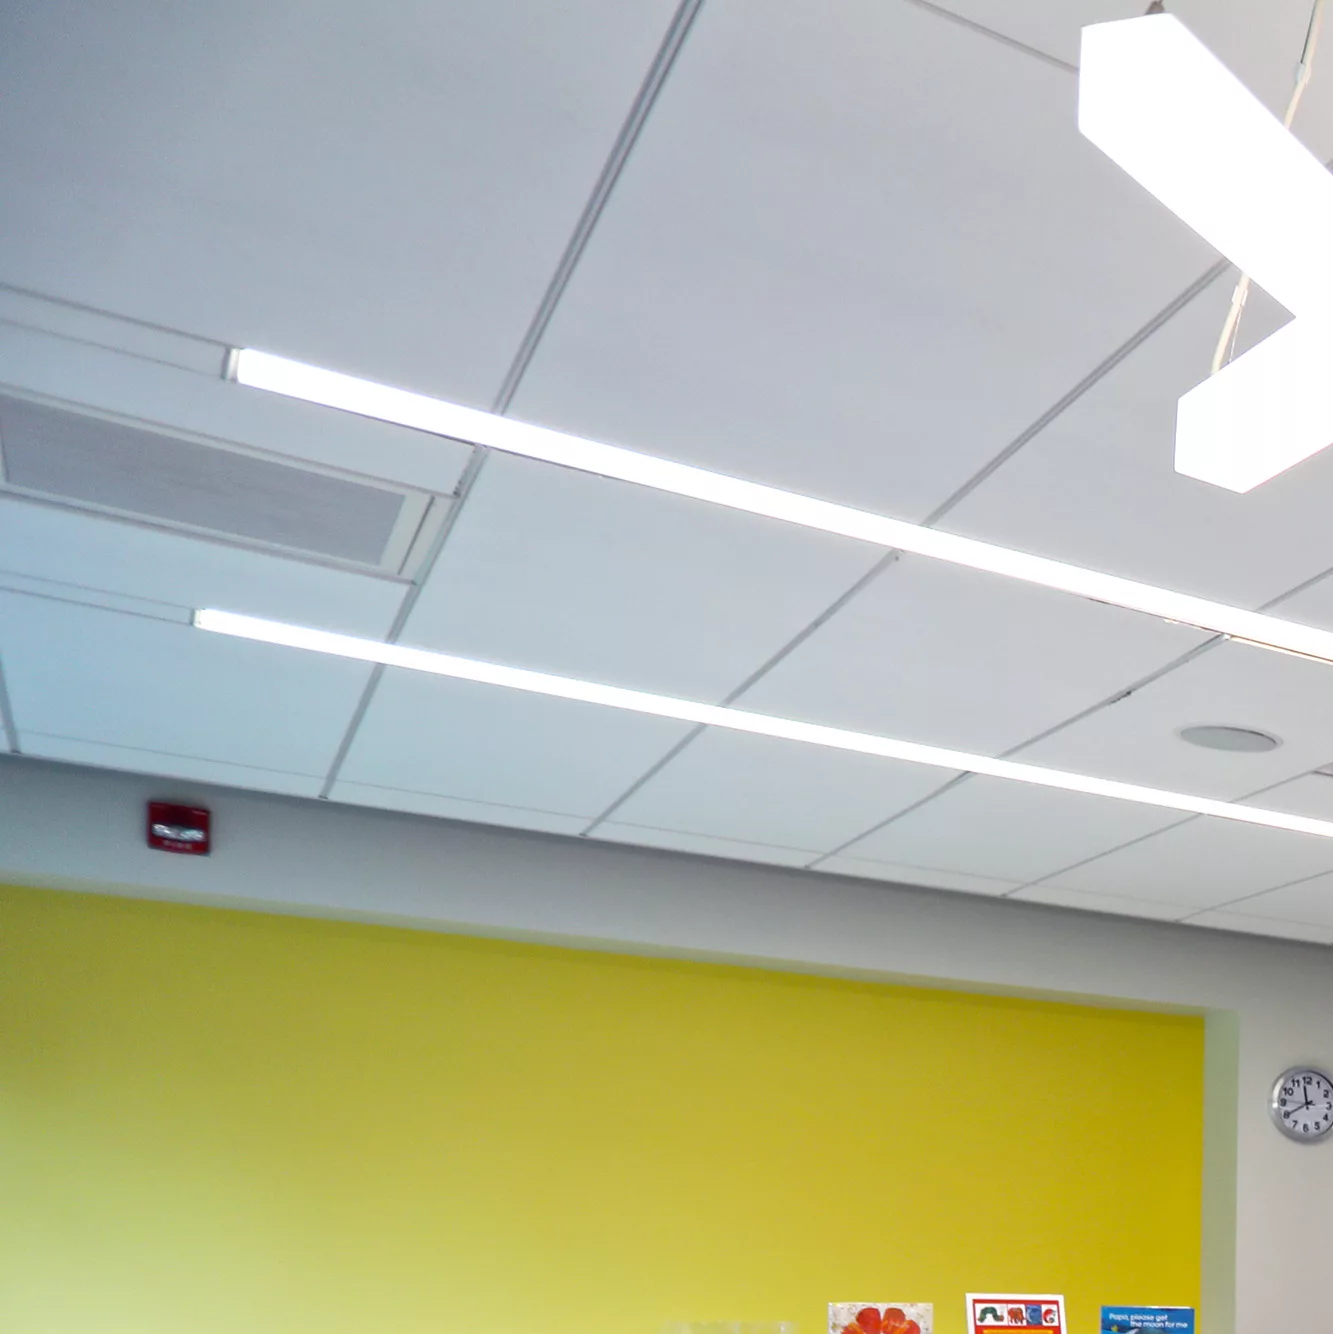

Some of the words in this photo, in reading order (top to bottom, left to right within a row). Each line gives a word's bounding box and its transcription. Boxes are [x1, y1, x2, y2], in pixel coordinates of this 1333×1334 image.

[1302, 1077, 1312, 1085] 12
[1283, 1088, 1293, 1096] 10
[1323, 1090, 1329, 1098] 2
[1280, 1098, 1287, 1106] 9
[1292, 1120, 1298, 1128] 7
[1303, 1124, 1309, 1132] 6
[1314, 1122, 1320, 1130] 5
[1156, 1313, 1168, 1321] get
